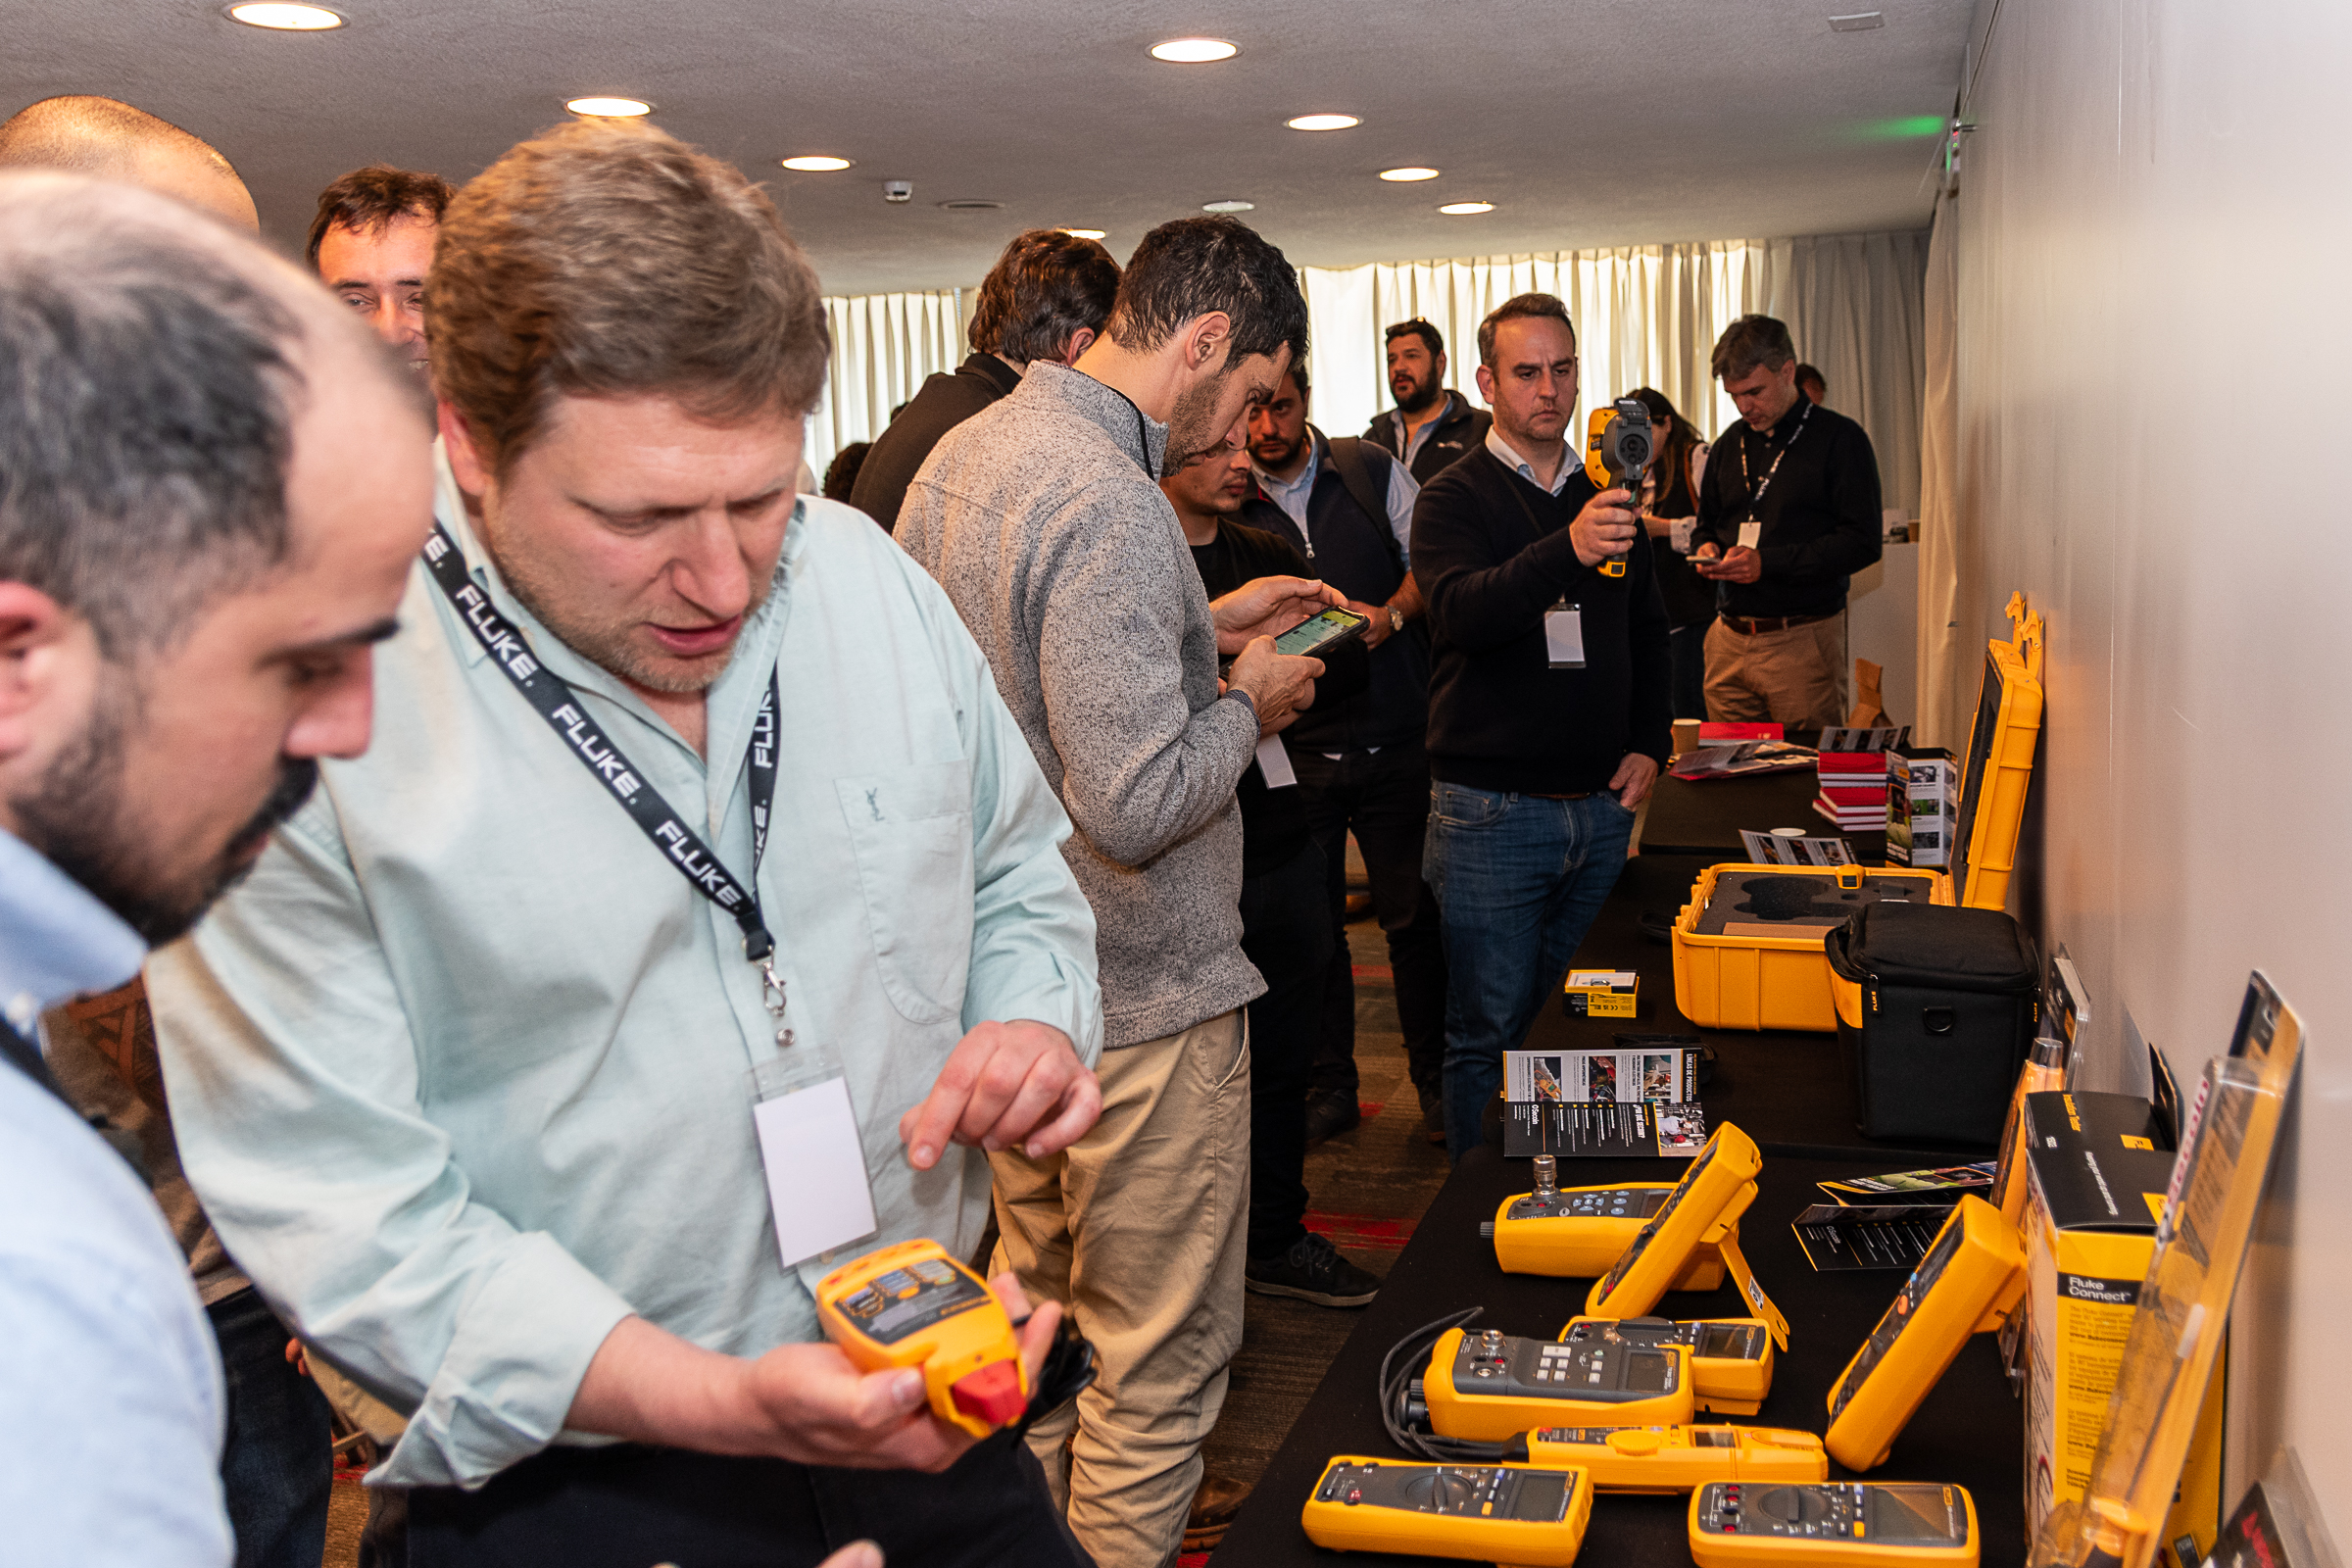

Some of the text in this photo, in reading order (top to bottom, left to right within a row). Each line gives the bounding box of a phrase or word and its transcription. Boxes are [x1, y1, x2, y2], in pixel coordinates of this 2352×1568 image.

[2062, 1094, 2082, 1132] Insulation Tester
[2069, 1276, 2105, 1291] Fluke
